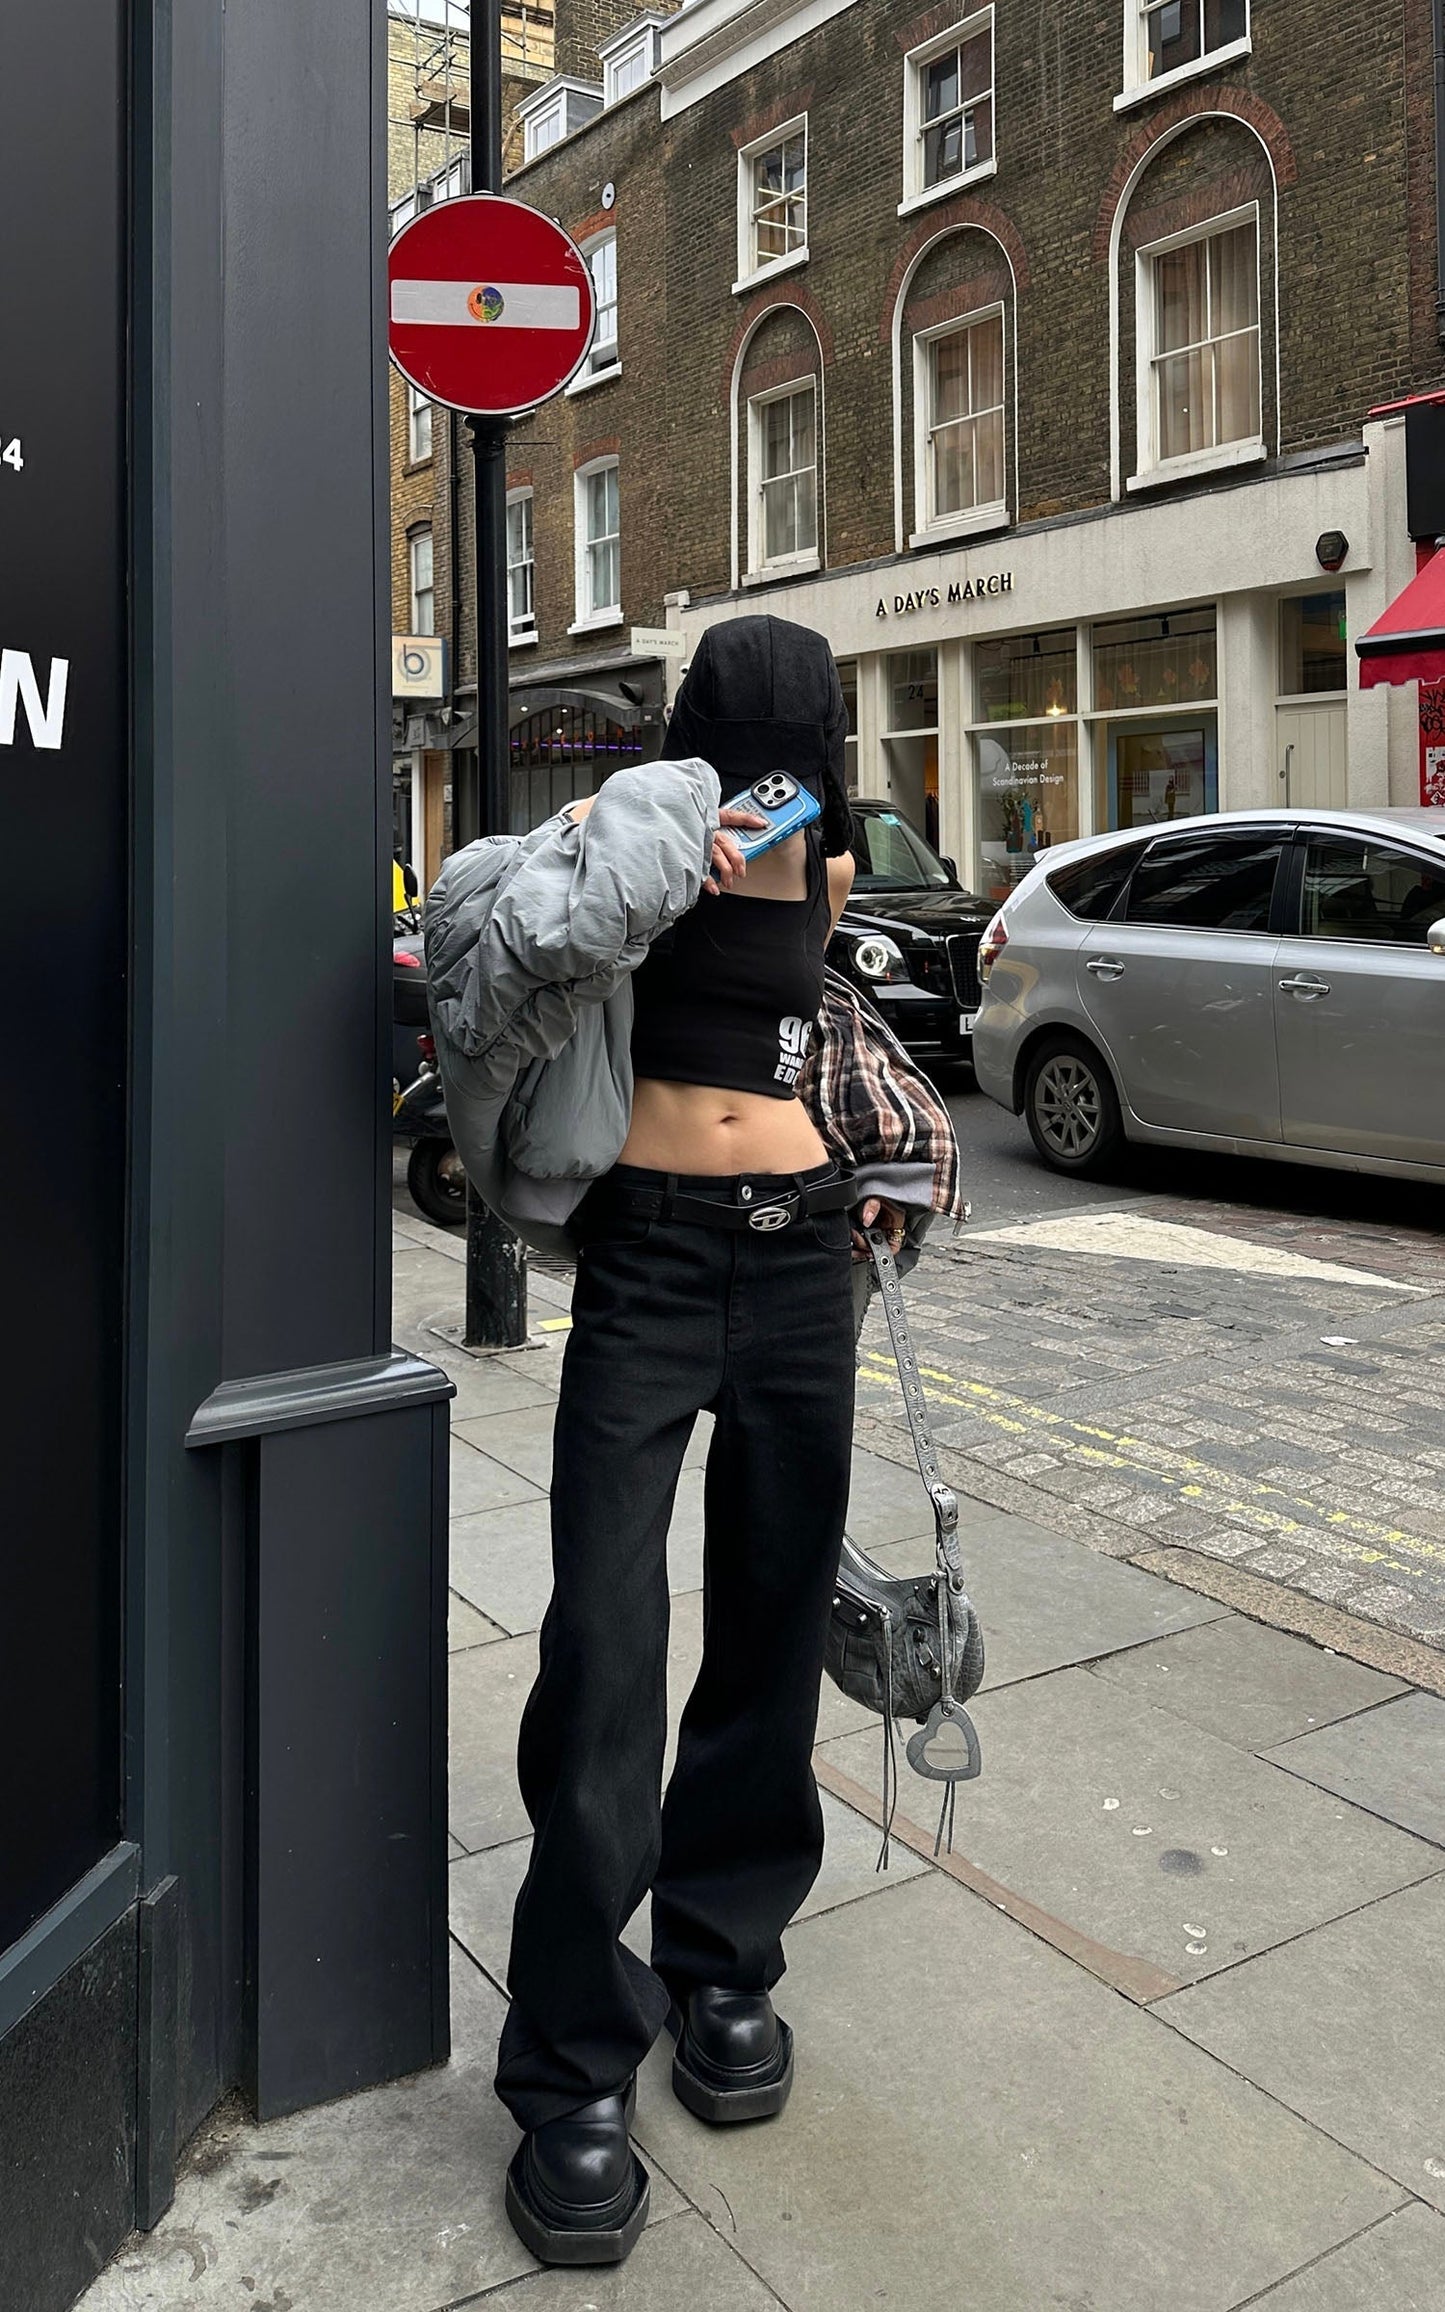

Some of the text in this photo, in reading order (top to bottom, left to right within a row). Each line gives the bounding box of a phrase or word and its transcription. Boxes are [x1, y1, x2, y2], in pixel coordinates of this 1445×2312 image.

[0, 438, 24, 471] 4
[876, 572, 1013, 617] A DAY'S MARCH
[1004, 759, 1049, 772] A Decade of
[992, 773, 1064, 786] Scandinavian Design
